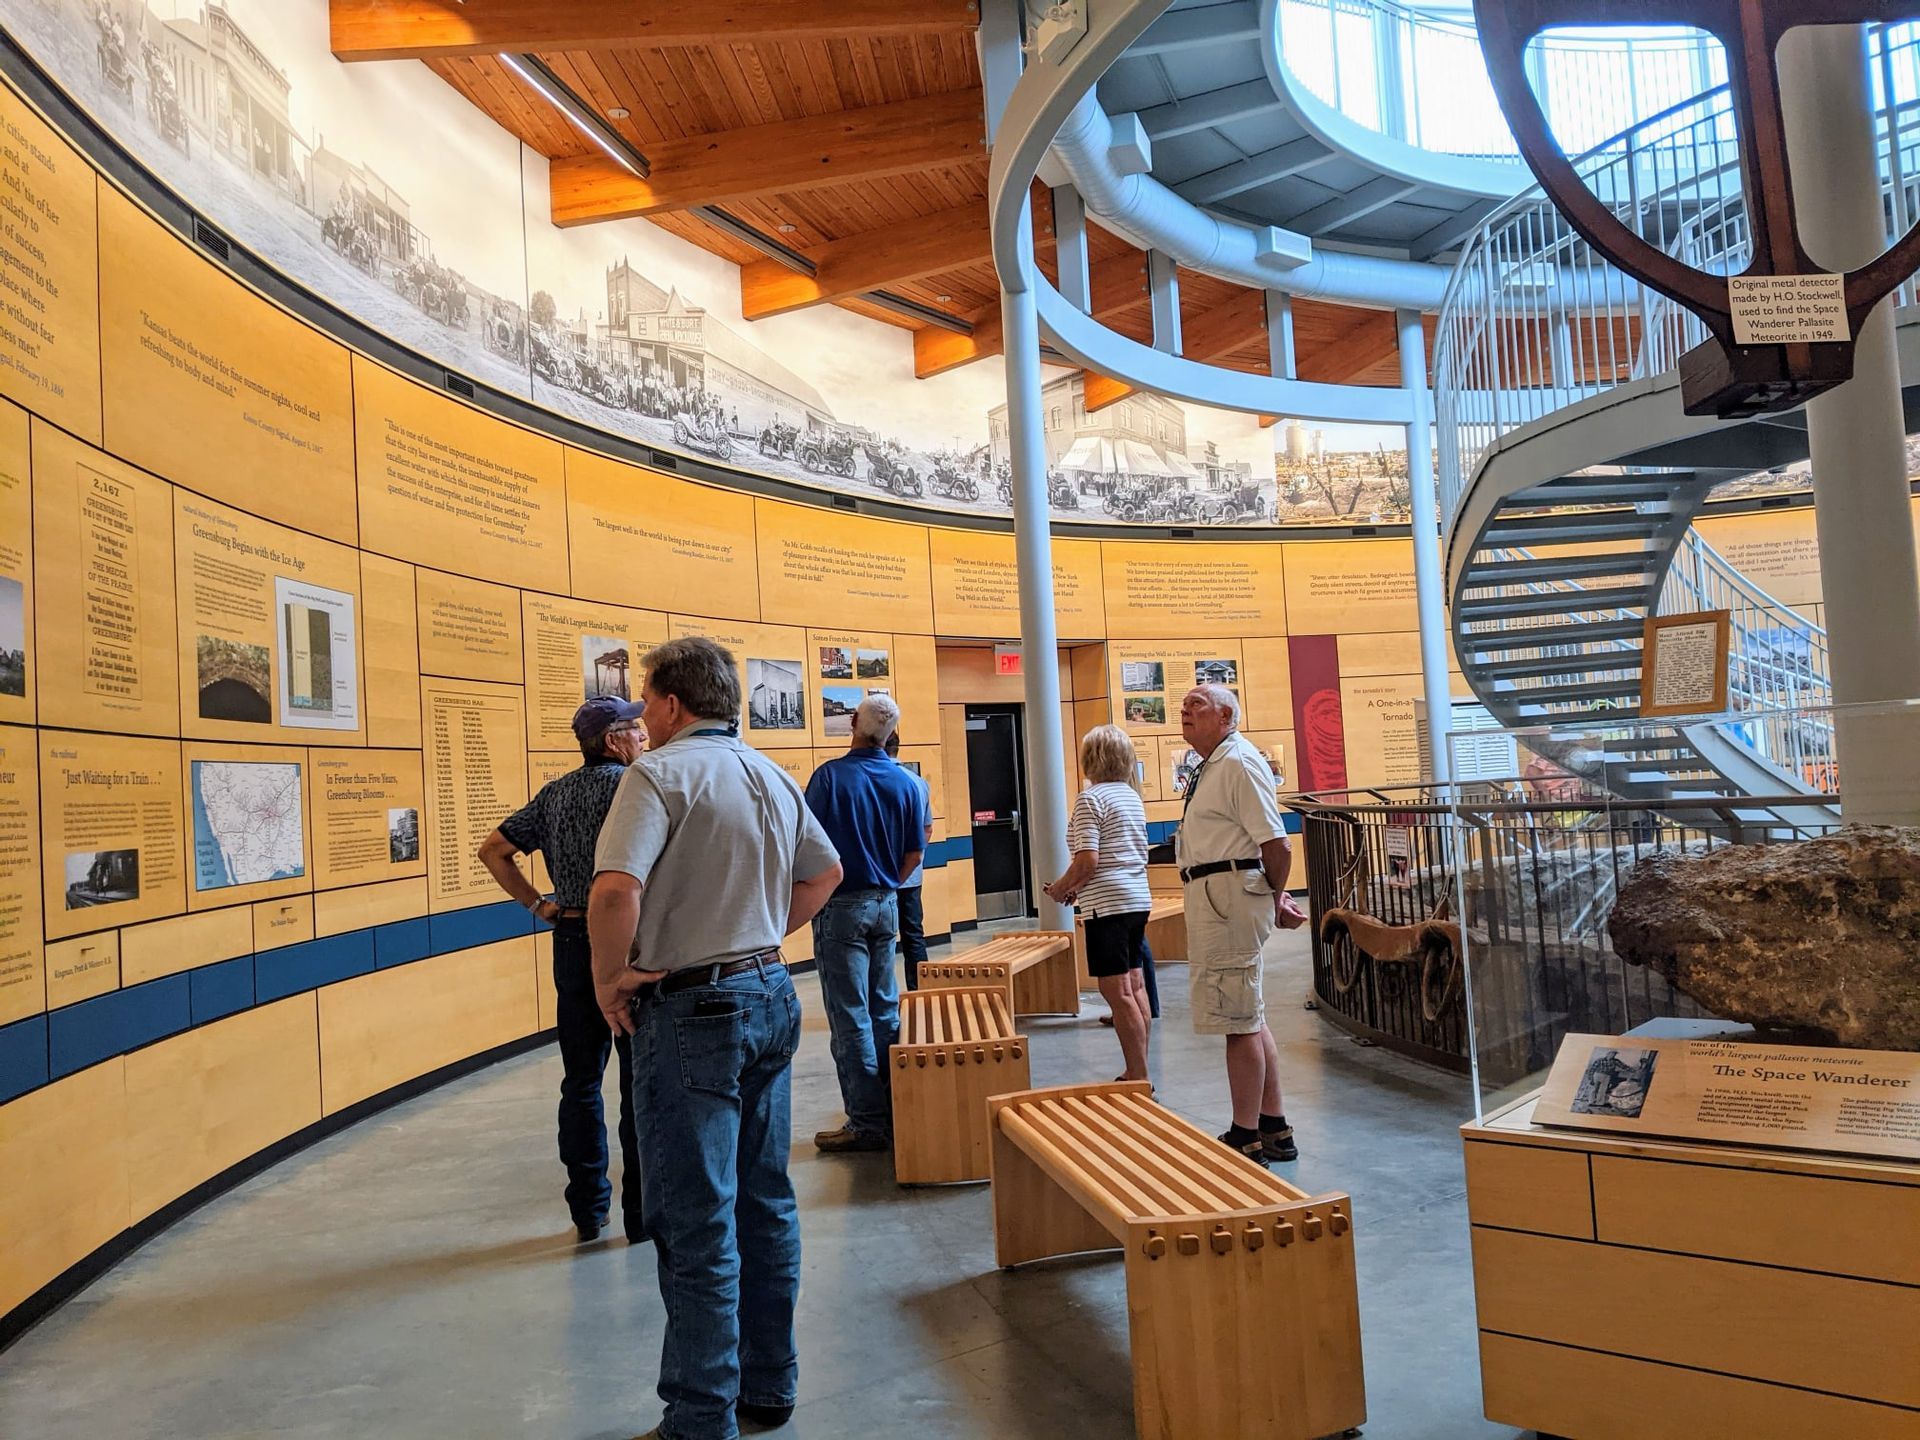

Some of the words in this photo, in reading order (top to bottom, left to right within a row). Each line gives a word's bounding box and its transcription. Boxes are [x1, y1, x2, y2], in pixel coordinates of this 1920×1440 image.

[7, 123, 28, 149] cities
[30, 145, 56, 174] stands
[4, 146, 20, 169] and
[21, 160, 30, 175] at
[2, 168, 21, 193] And
[46, 203, 60, 225] her
[31, 219, 38, 233] to
[5, 222, 14, 241] of
[16, 231, 47, 269] success,
[36, 271, 44, 288] to
[46, 278, 58, 298] the
[1732, 279, 1769, 292] Original
[1771, 279, 1797, 289] metal
[1799, 278, 1840, 288] detector
[21, 286, 46, 314] where
[1732, 294, 1758, 304] made
[1760, 293, 1771, 305] by
[1773, 291, 1796, 302] H.O.
[1798, 290, 1843, 302] Stockwell,
[1739, 307, 1761, 317] used
[1763, 308, 1774, 316] to
[1776, 305, 1794, 315] find
[1796, 303, 1811, 314] the
[1813, 304, 1840, 316] Space
[6, 303, 38, 335] without
[40, 323, 55, 345] fear
[1748, 319, 1796, 329] Wanderer
[1798, 317, 1835, 328] Pallasite
[1751, 332, 1798, 343] Meteorite
[1799, 331, 1809, 341] in
[1812, 330, 1837, 340] 1949.
[140, 335, 174, 369] refreshing
[176, 359, 183, 370] to
[184, 361, 200, 382] body
[187, 342, 198, 359] the
[200, 352, 218, 371] world
[220, 361, 229, 377] for
[294, 402, 307, 417] cool
[424, 436, 433, 447] the
[449, 445, 476, 464] important
[459, 463, 467, 474] the
[192, 523, 232, 551] Greensburg
[232, 536, 253, 555] Begins
[254, 544, 268, 559] with
[269, 549, 280, 563] the
[282, 553, 291, 565] Ice
[292, 556, 305, 572] Age
[570, 617, 588, 630] Largest
[1382, 711, 1414, 721] Tornado
[83, 769, 112, 790] Waiting
[113, 770, 123, 785] for
[130, 771, 149, 785] Train
[326, 773, 333, 785] In
[335, 773, 353, 785] Fewer
[354, 772, 368, 785] than
[369, 773, 381, 785] Five
[327, 789, 362, 803] Greensburg
[363, 788, 385, 800] Blooms
[1710, 1041, 1720, 1049] of
[1722, 1042, 1738, 1050] the
[1689, 1050, 1726, 1061] world's
[1727, 1051, 1762, 1064] largest
[1763, 1054, 1808, 1067] pallasite
[1811, 1056, 1864, 1067] meteorite
[1712, 1064, 1747, 1079] The
[1751, 1066, 1807, 1086] Space
[1812, 1070, 1912, 1089] Wanderer
